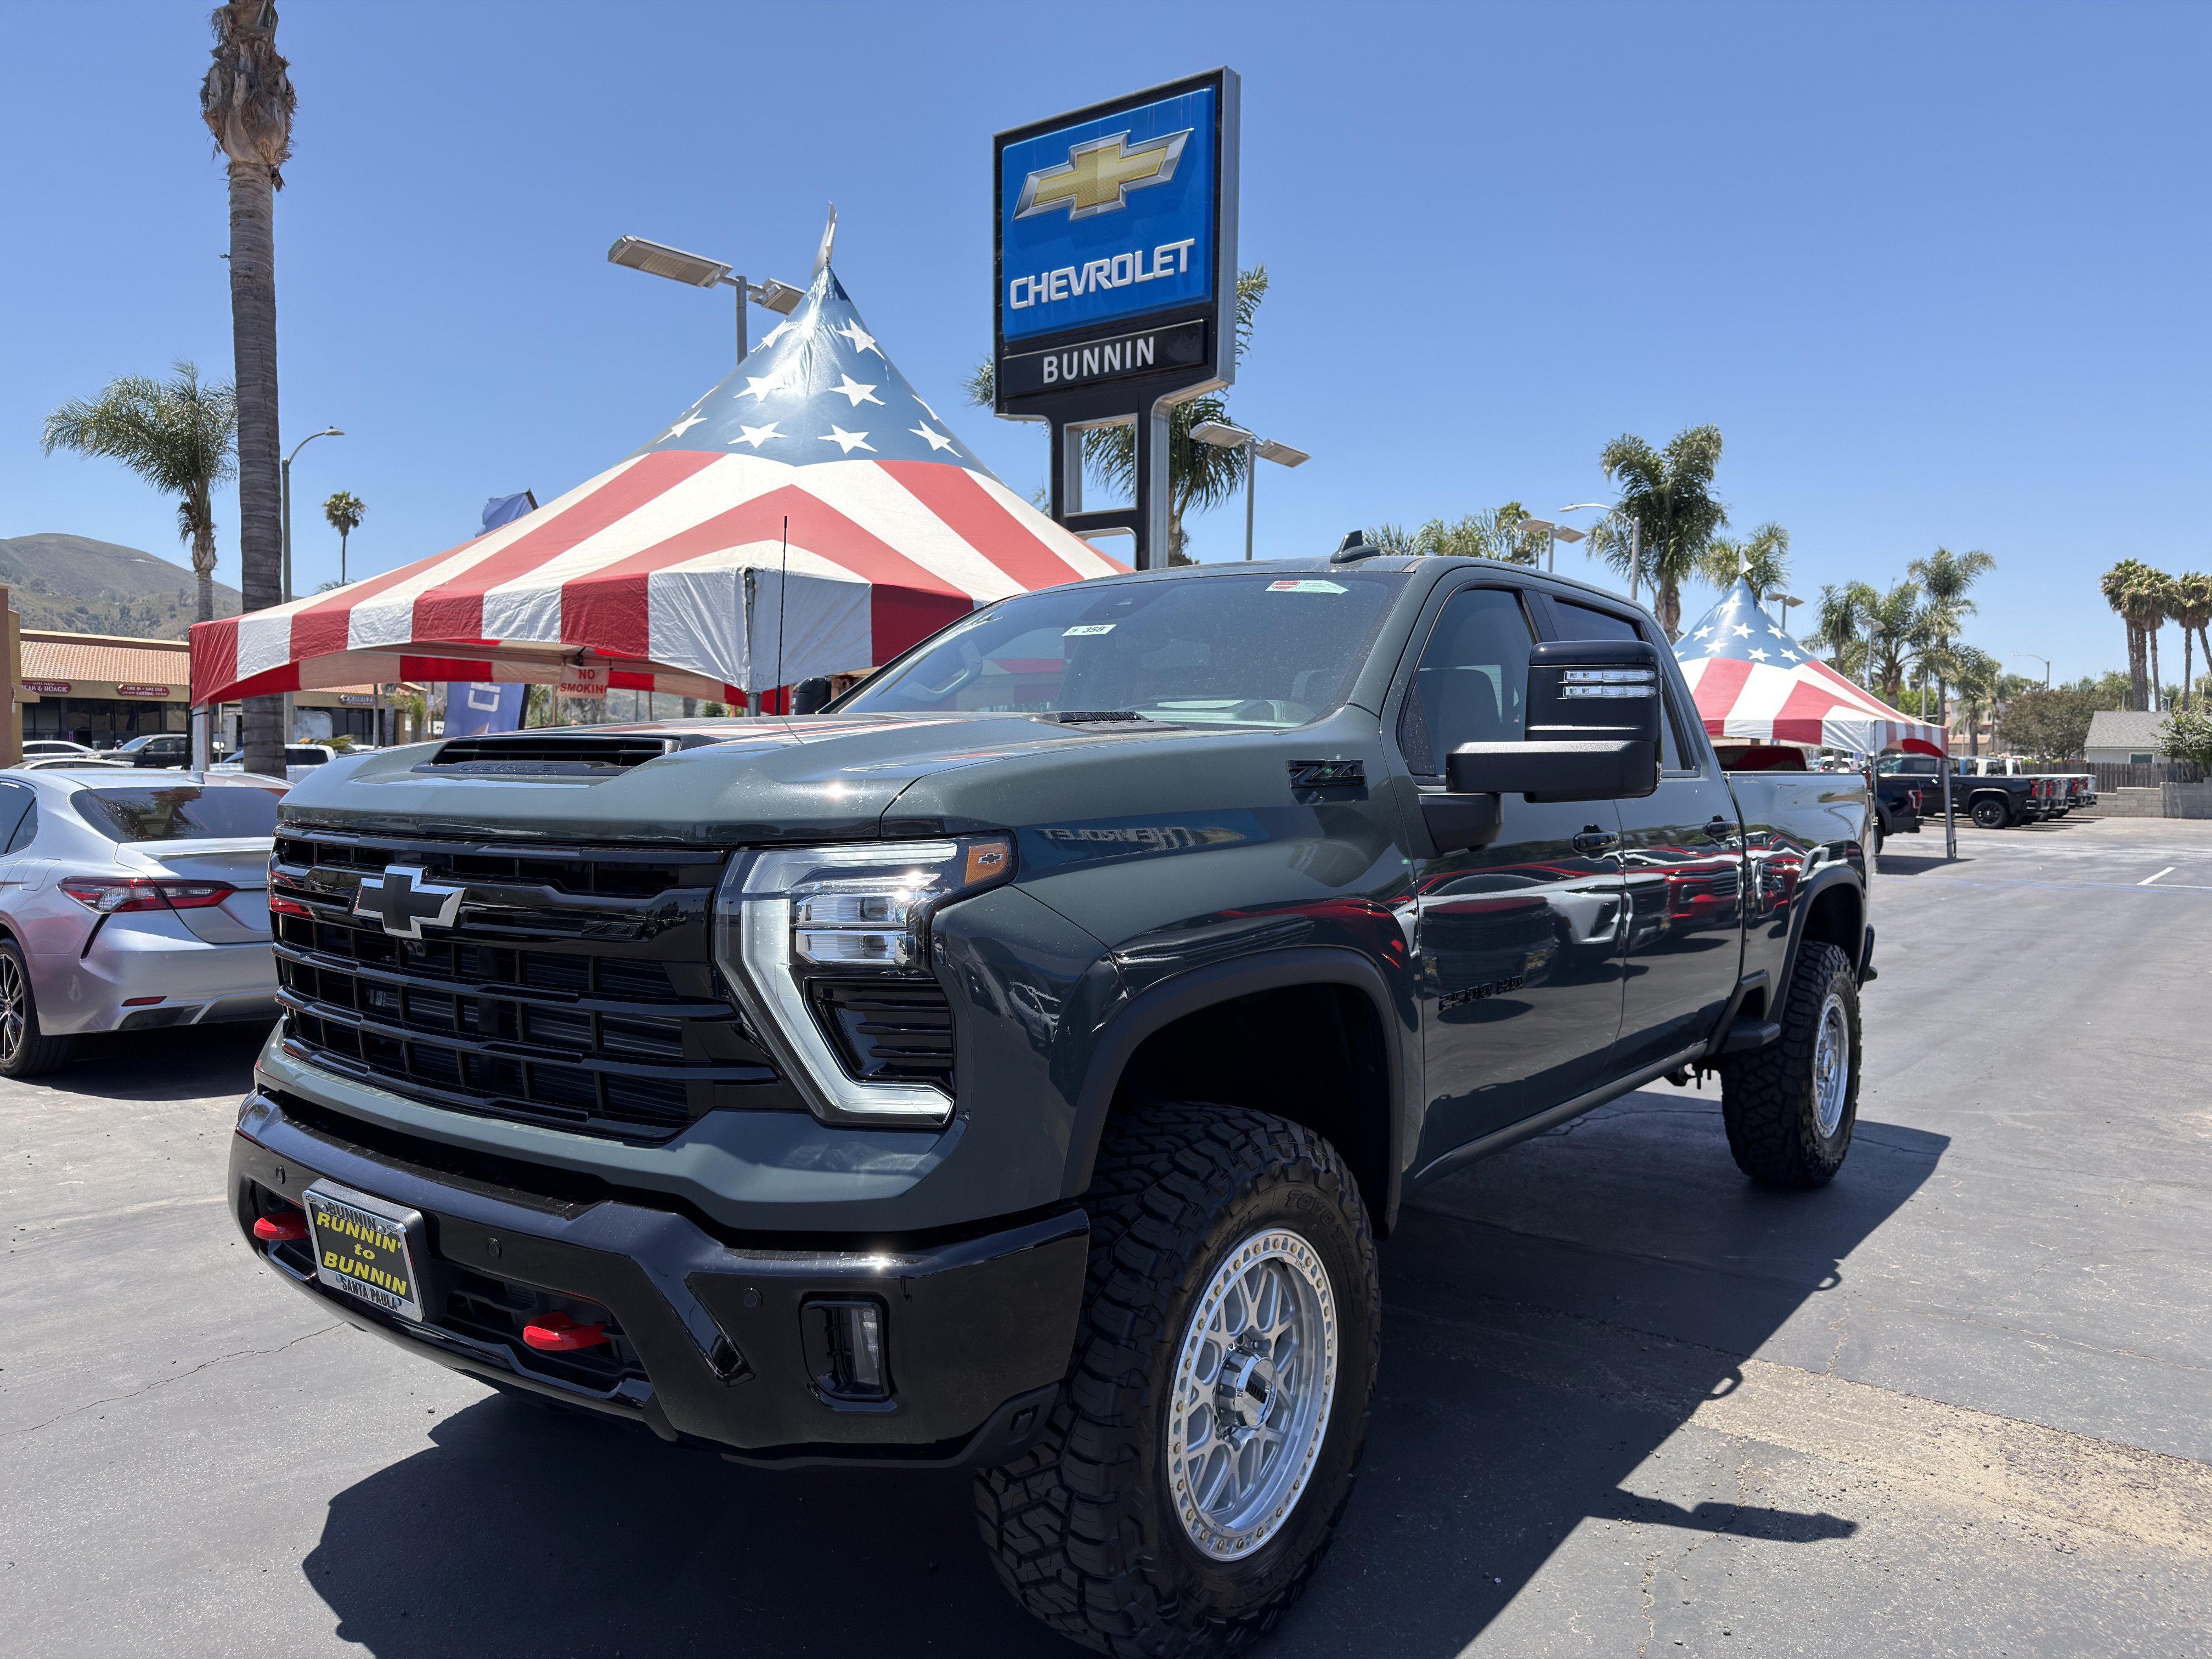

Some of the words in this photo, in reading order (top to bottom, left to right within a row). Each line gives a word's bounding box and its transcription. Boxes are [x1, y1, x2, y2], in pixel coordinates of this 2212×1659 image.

[1010, 238, 1195, 310] CHEVROLET
[1043, 336, 1154, 383] BUNNIN
[560, 682, 607, 694] SMOKIN
[579, 669, 595, 679] NO
[460, 764, 567, 772] CHEVROLET
[1438, 983, 1492, 1011] 2500
[1497, 975, 1522, 994] HD
[328, 1201, 376, 1231] BUNNIN
[1285, 1189, 1336, 1227] TOYO
[317, 1211, 402, 1253] RUNNIN'
[354, 1243, 375, 1260] to
[1295, 1259, 1306, 1272] KMC
[324, 1251, 407, 1296] BUNNIN
[342, 1277, 369, 1300] SANTA
[371, 1289, 399, 1312] PAULA
